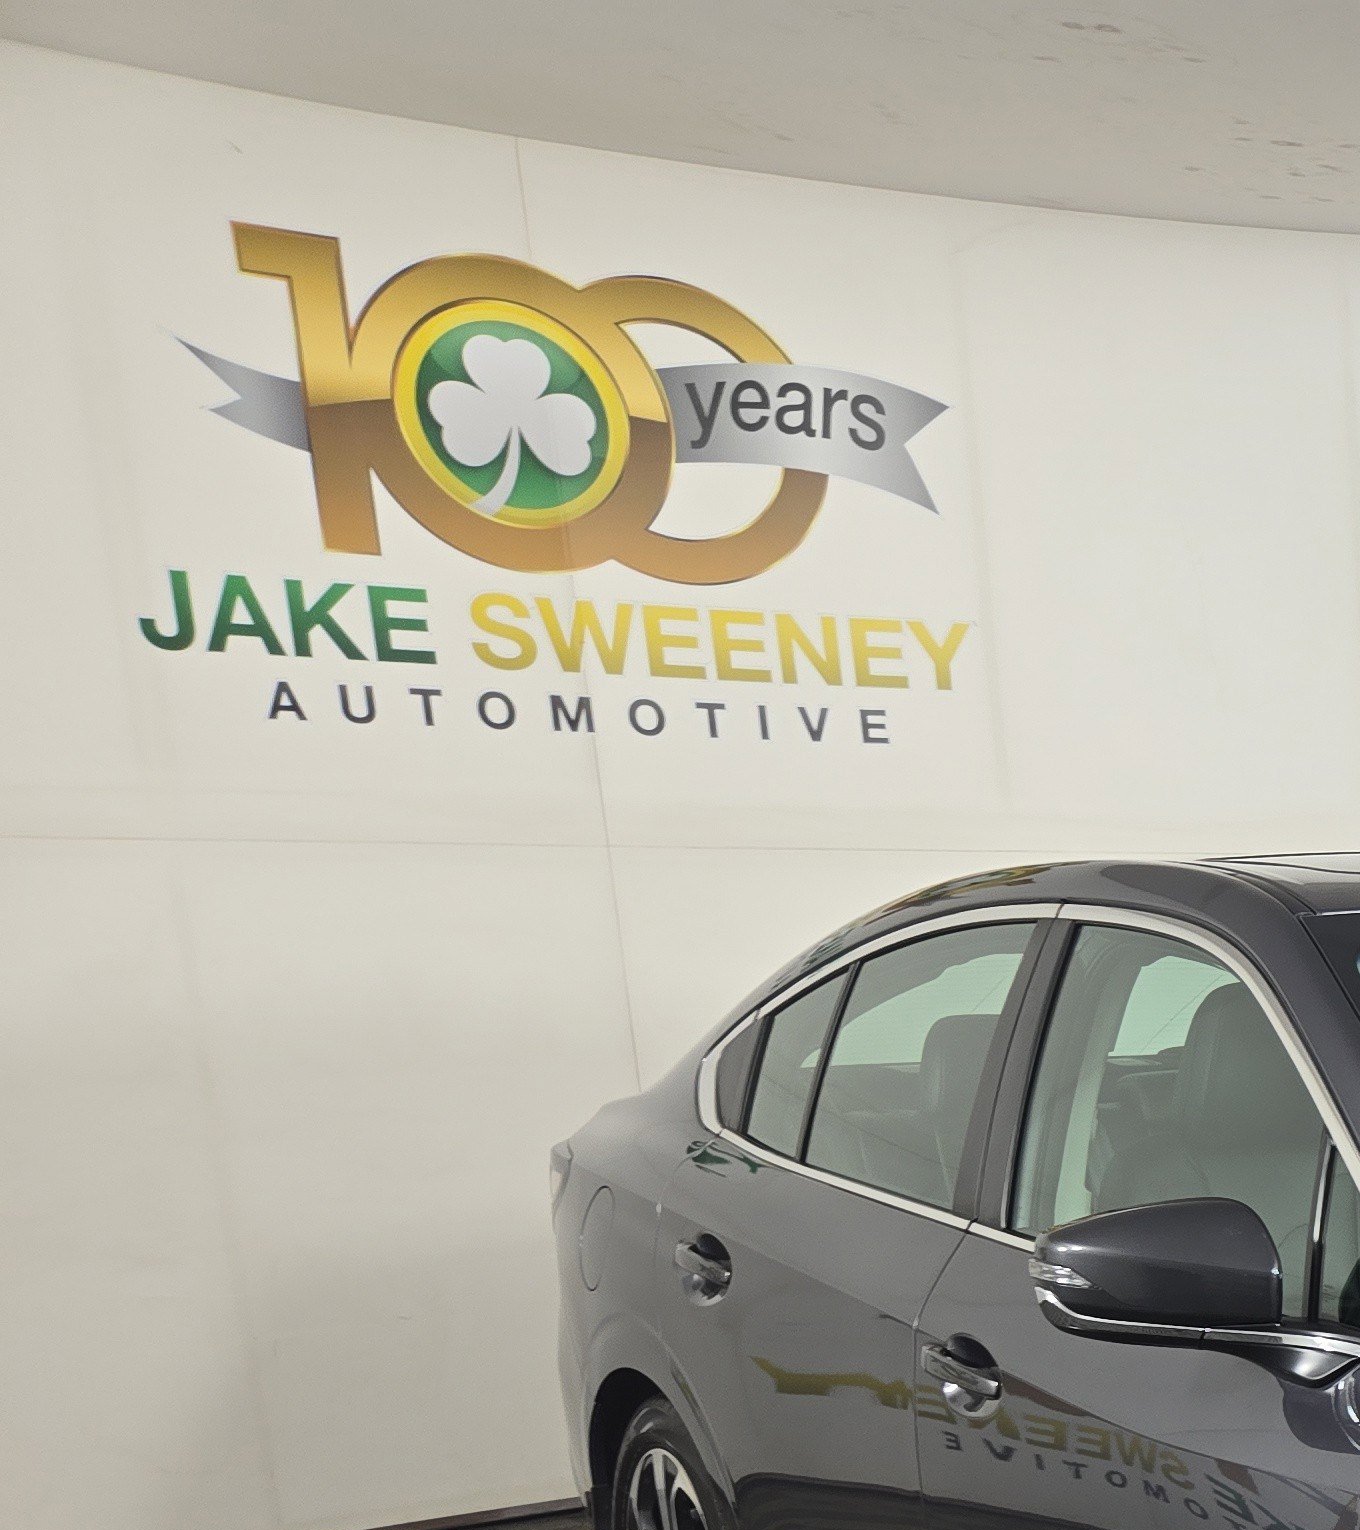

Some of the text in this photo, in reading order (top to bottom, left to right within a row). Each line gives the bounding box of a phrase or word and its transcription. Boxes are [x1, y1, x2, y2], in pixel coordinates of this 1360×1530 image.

[231, 221, 887, 585] 100 years
[138, 568, 971, 692] JAKE SWEENEY
[268, 680, 891, 744] AUTOMOTIVE
